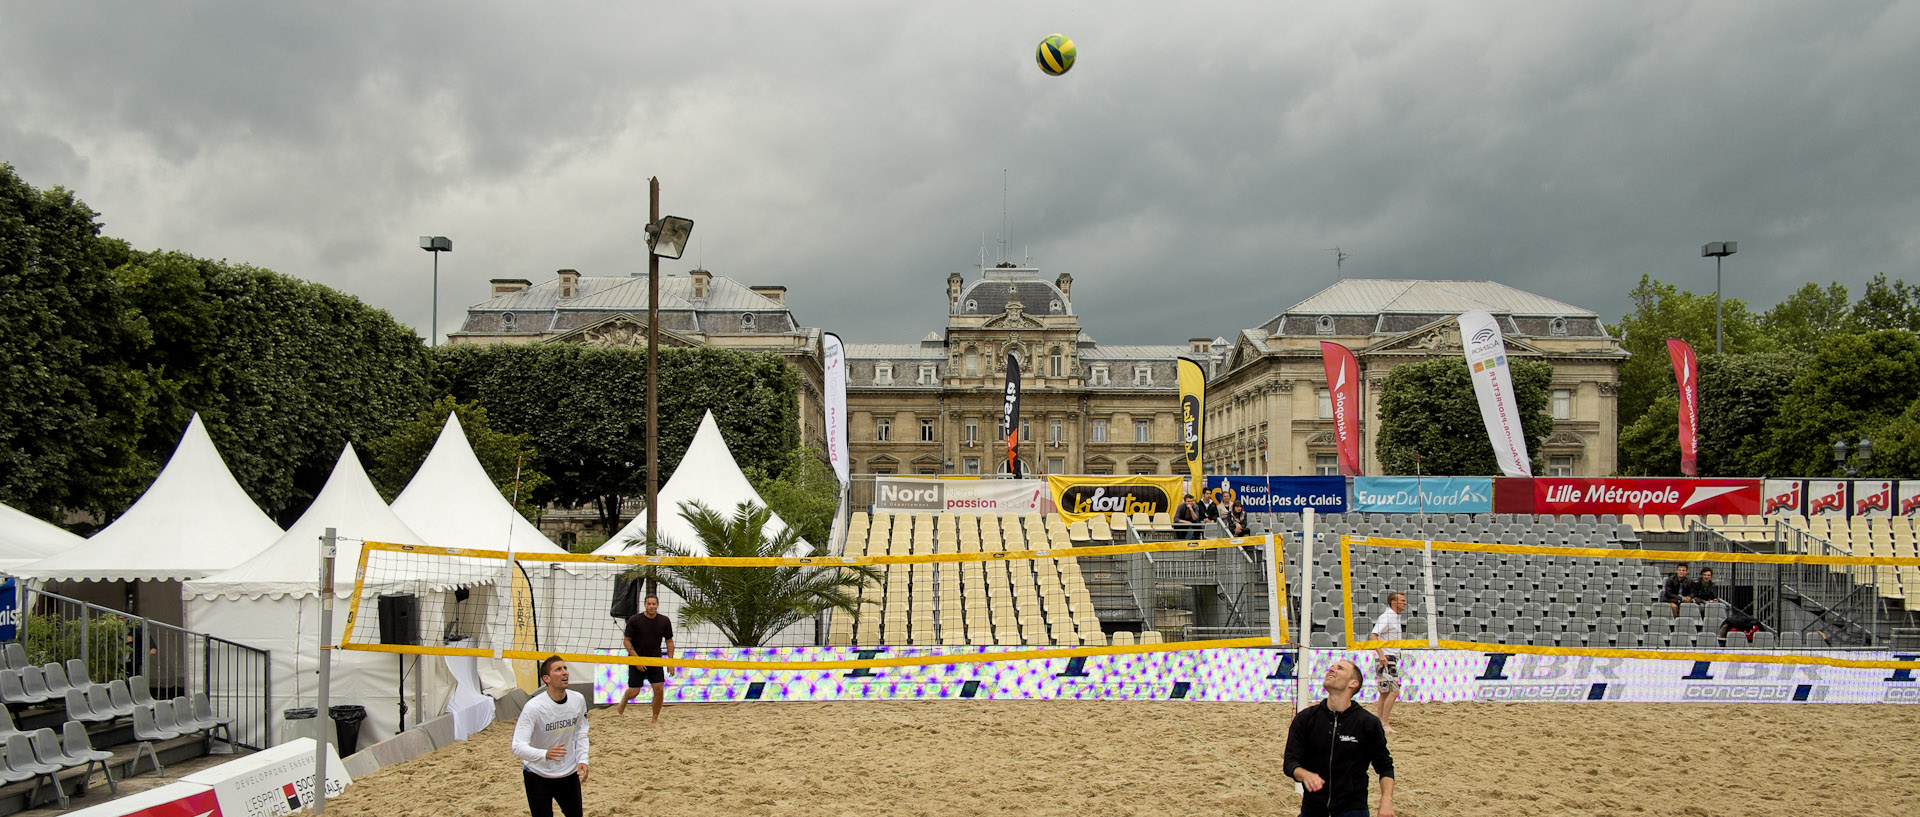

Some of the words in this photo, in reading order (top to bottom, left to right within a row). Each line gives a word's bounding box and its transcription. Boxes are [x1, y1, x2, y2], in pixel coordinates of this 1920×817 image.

[880, 484, 939, 502] Nord
[1240, 485, 1269, 493] RÉGION
[1545, 484, 1582, 503] Lille
[1584, 484, 1680, 509] Métropole
[947, 498, 997, 510] passion
[1073, 487, 1157, 517] kiloutou
[1297, 494, 1307, 506] de
[1308, 493, 1342, 506] Calais
[1901, 494, 1920, 516] NR
[1480, 686, 1584, 699] concept
[1686, 686, 1789, 699] concept
[245, 787, 282, 813] L'ESPRIT
[301, 779, 342, 805] GENALE
